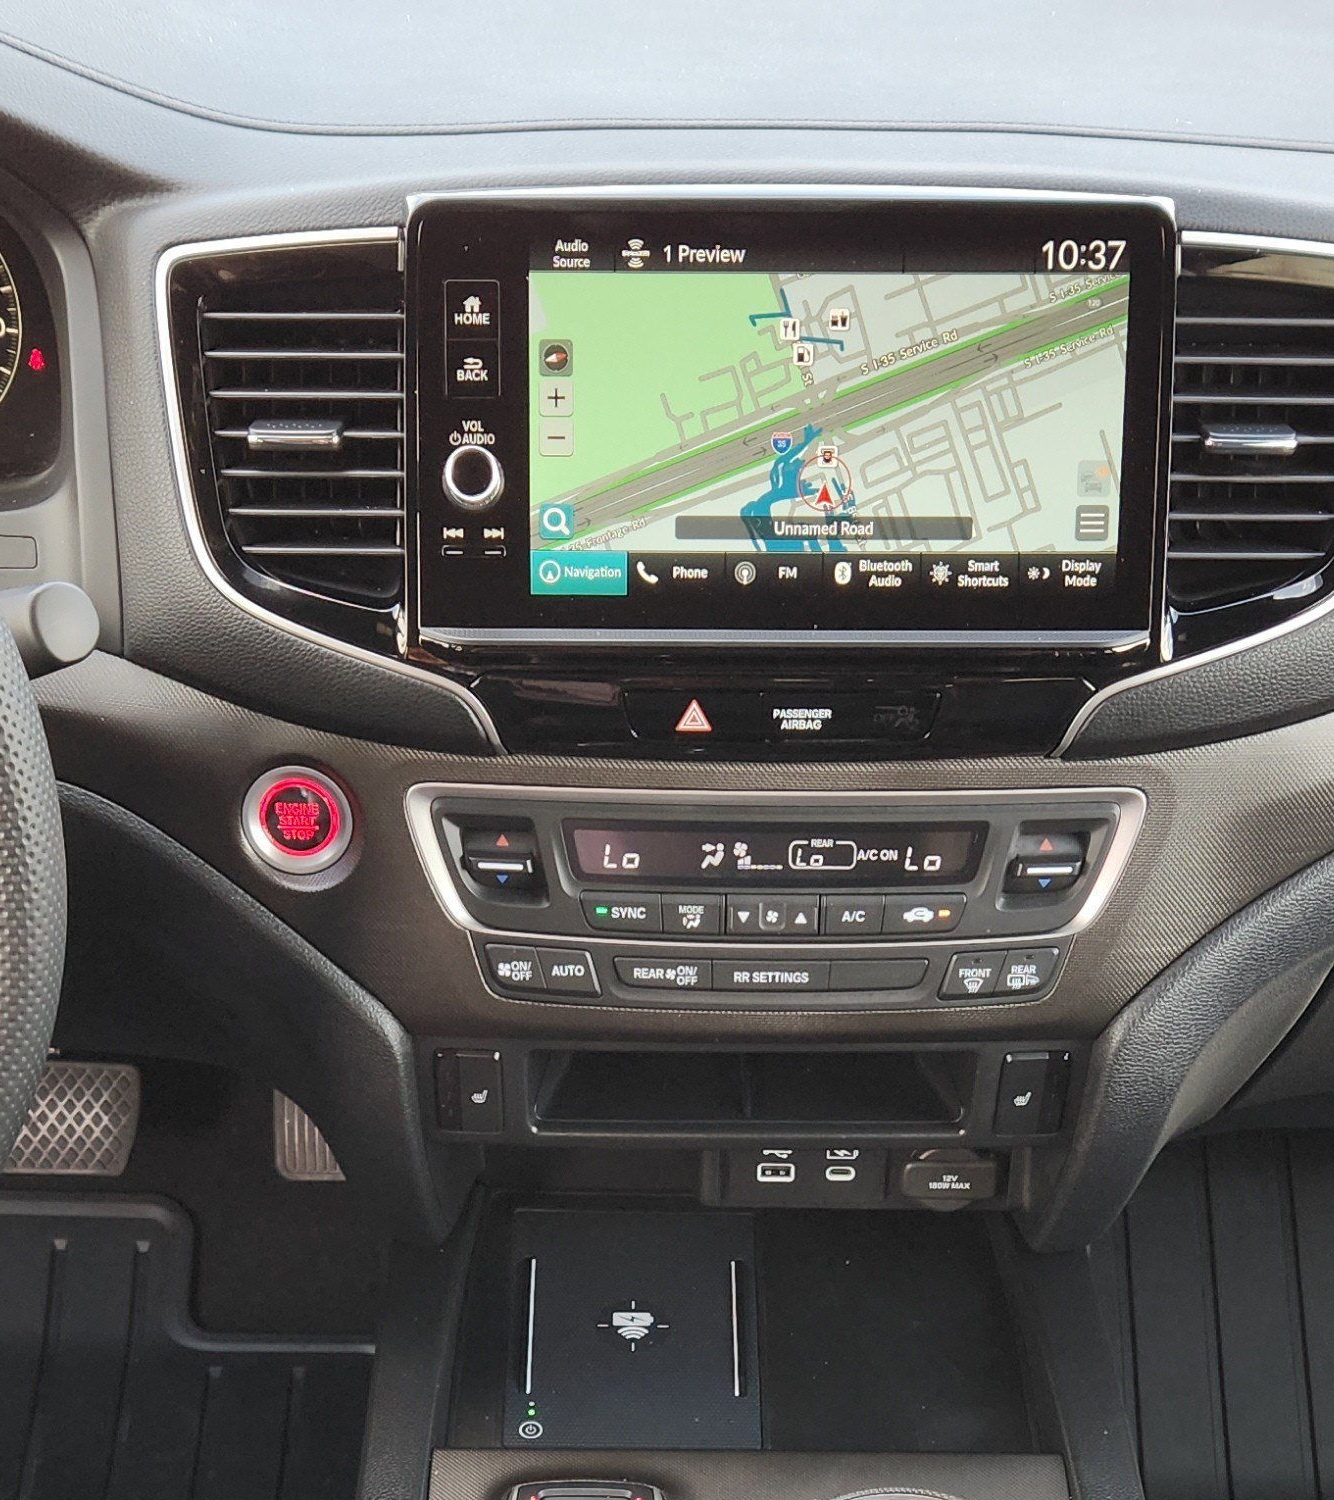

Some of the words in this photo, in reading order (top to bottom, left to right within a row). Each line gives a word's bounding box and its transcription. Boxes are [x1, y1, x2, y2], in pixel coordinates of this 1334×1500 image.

[554, 239, 589, 252] Audio
[663, 245, 672, 263] 1
[678, 244, 747, 263] Preview
[1041, 240, 1127, 271] 10:37
[552, 256, 591, 268] Source
[454, 313, 490, 325] HOME
[861, 364, 869, 375] S
[872, 352, 897, 370] I-35
[900, 339, 939, 360] Service
[942, 329, 958, 344] Rd
[1024, 358, 1032, 368] S
[1060, 333, 1097, 354] Service
[1099, 324, 1114, 338] Rd
[456, 370, 489, 382] BACK
[461, 420, 485, 433] VOL
[462, 433, 496, 445] AUDIO
[631, 517, 647, 531] Rd
[773, 521, 838, 537] Unnamed
[840, 521, 875, 537] Road
[563, 565, 622, 581] Navigation
[672, 565, 709, 580] Phone
[777, 566, 799, 580] FM
[858, 559, 914, 574] Bluetooth
[967, 560, 1001, 574] Smart
[1061, 560, 1103, 575] Display
[868, 574, 903, 588] Audio
[957, 574, 1010, 588] Shortcuts
[1064, 575, 1098, 588] Mode
[772, 708, 834, 720] PASSENGER
[780, 719, 823, 731] AIRBAG
[274, 802, 320, 816] ENGINE
[278, 816, 317, 826] START
[283, 829, 316, 841] STOP
[810, 839, 835, 848] REAR
[603, 843, 641, 870] Lo
[856, 849, 879, 862] A/C
[880, 849, 898, 862] ON
[903, 846, 942, 872] Lo
[610, 906, 647, 920] SYNC
[678, 904, 705, 915] MODE
[841, 910, 866, 923] A/C
[510, 961, 533, 971] ON/
[551, 965, 585, 977] AUTO
[633, 967, 665, 980] REAR
[676, 965, 699, 976] ON/
[1010, 964, 1037, 975] REAR
[511, 971, 533, 982] OFF
[733, 971, 751, 983] RR
[751, 971, 810, 984] SETTINGS
[958, 968, 993, 979] FRONT
[676, 976, 699, 986] OFF
[942, 1174, 959, 1182] 12V
[950, 1181, 971, 1190] MAX
